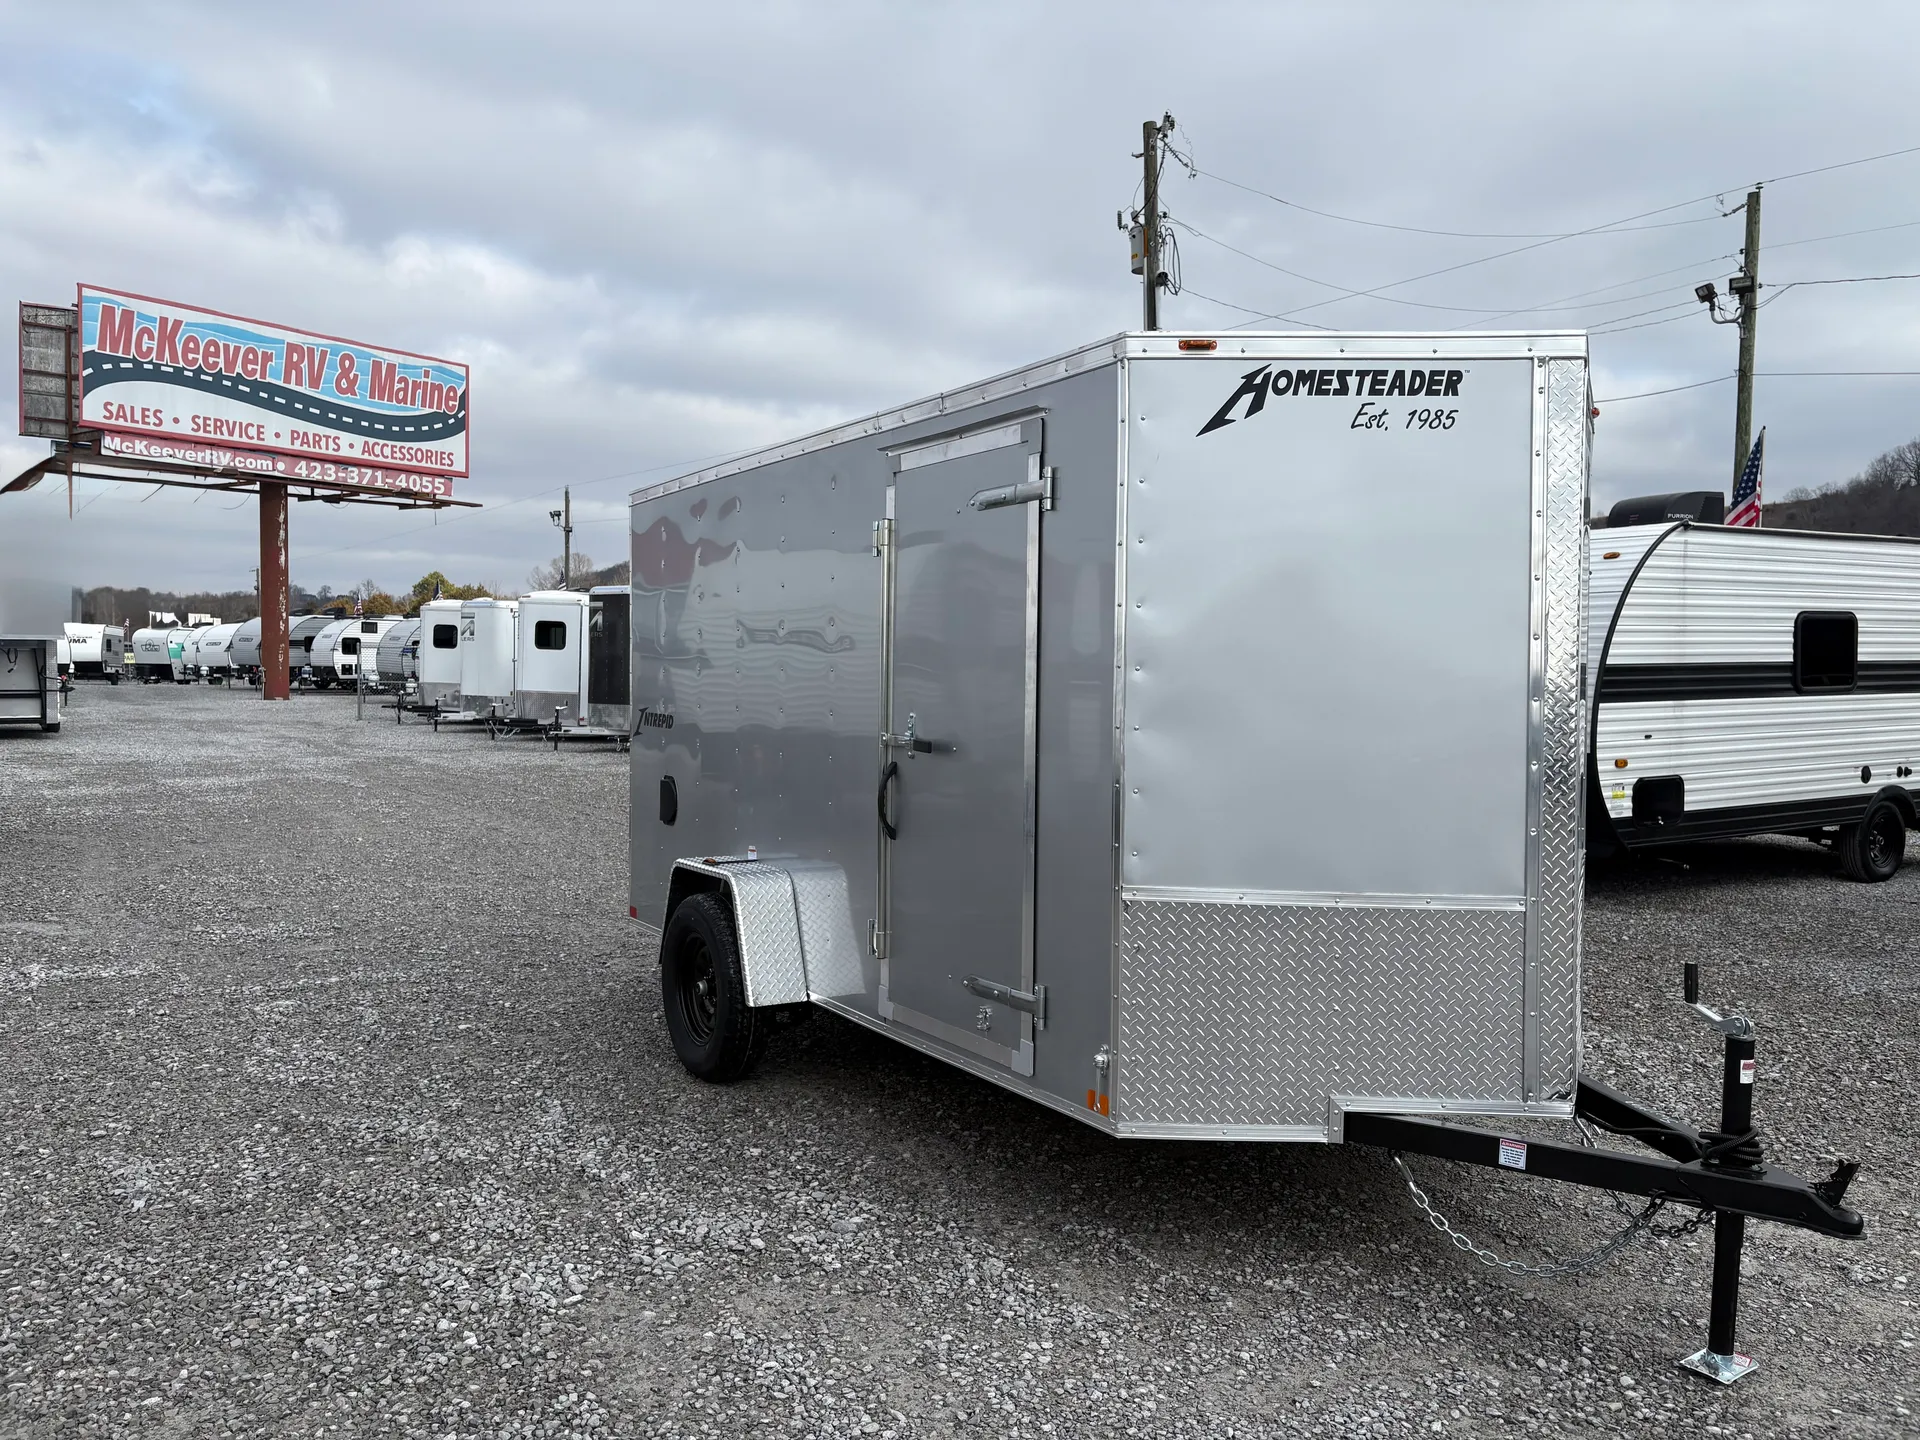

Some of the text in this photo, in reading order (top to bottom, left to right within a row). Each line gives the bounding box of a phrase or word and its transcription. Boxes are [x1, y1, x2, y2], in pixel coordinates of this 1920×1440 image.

[96, 303, 459, 414] McKeever RV & Marine
[102, 401, 454, 468] SALES SERVICE PARTS ACCESSORIES
[1405, 408, 1459, 430] 1985
[103, 435, 446, 494] McKeeverRV.com 423-371-4055
[632, 706, 674, 738] INTREPID
